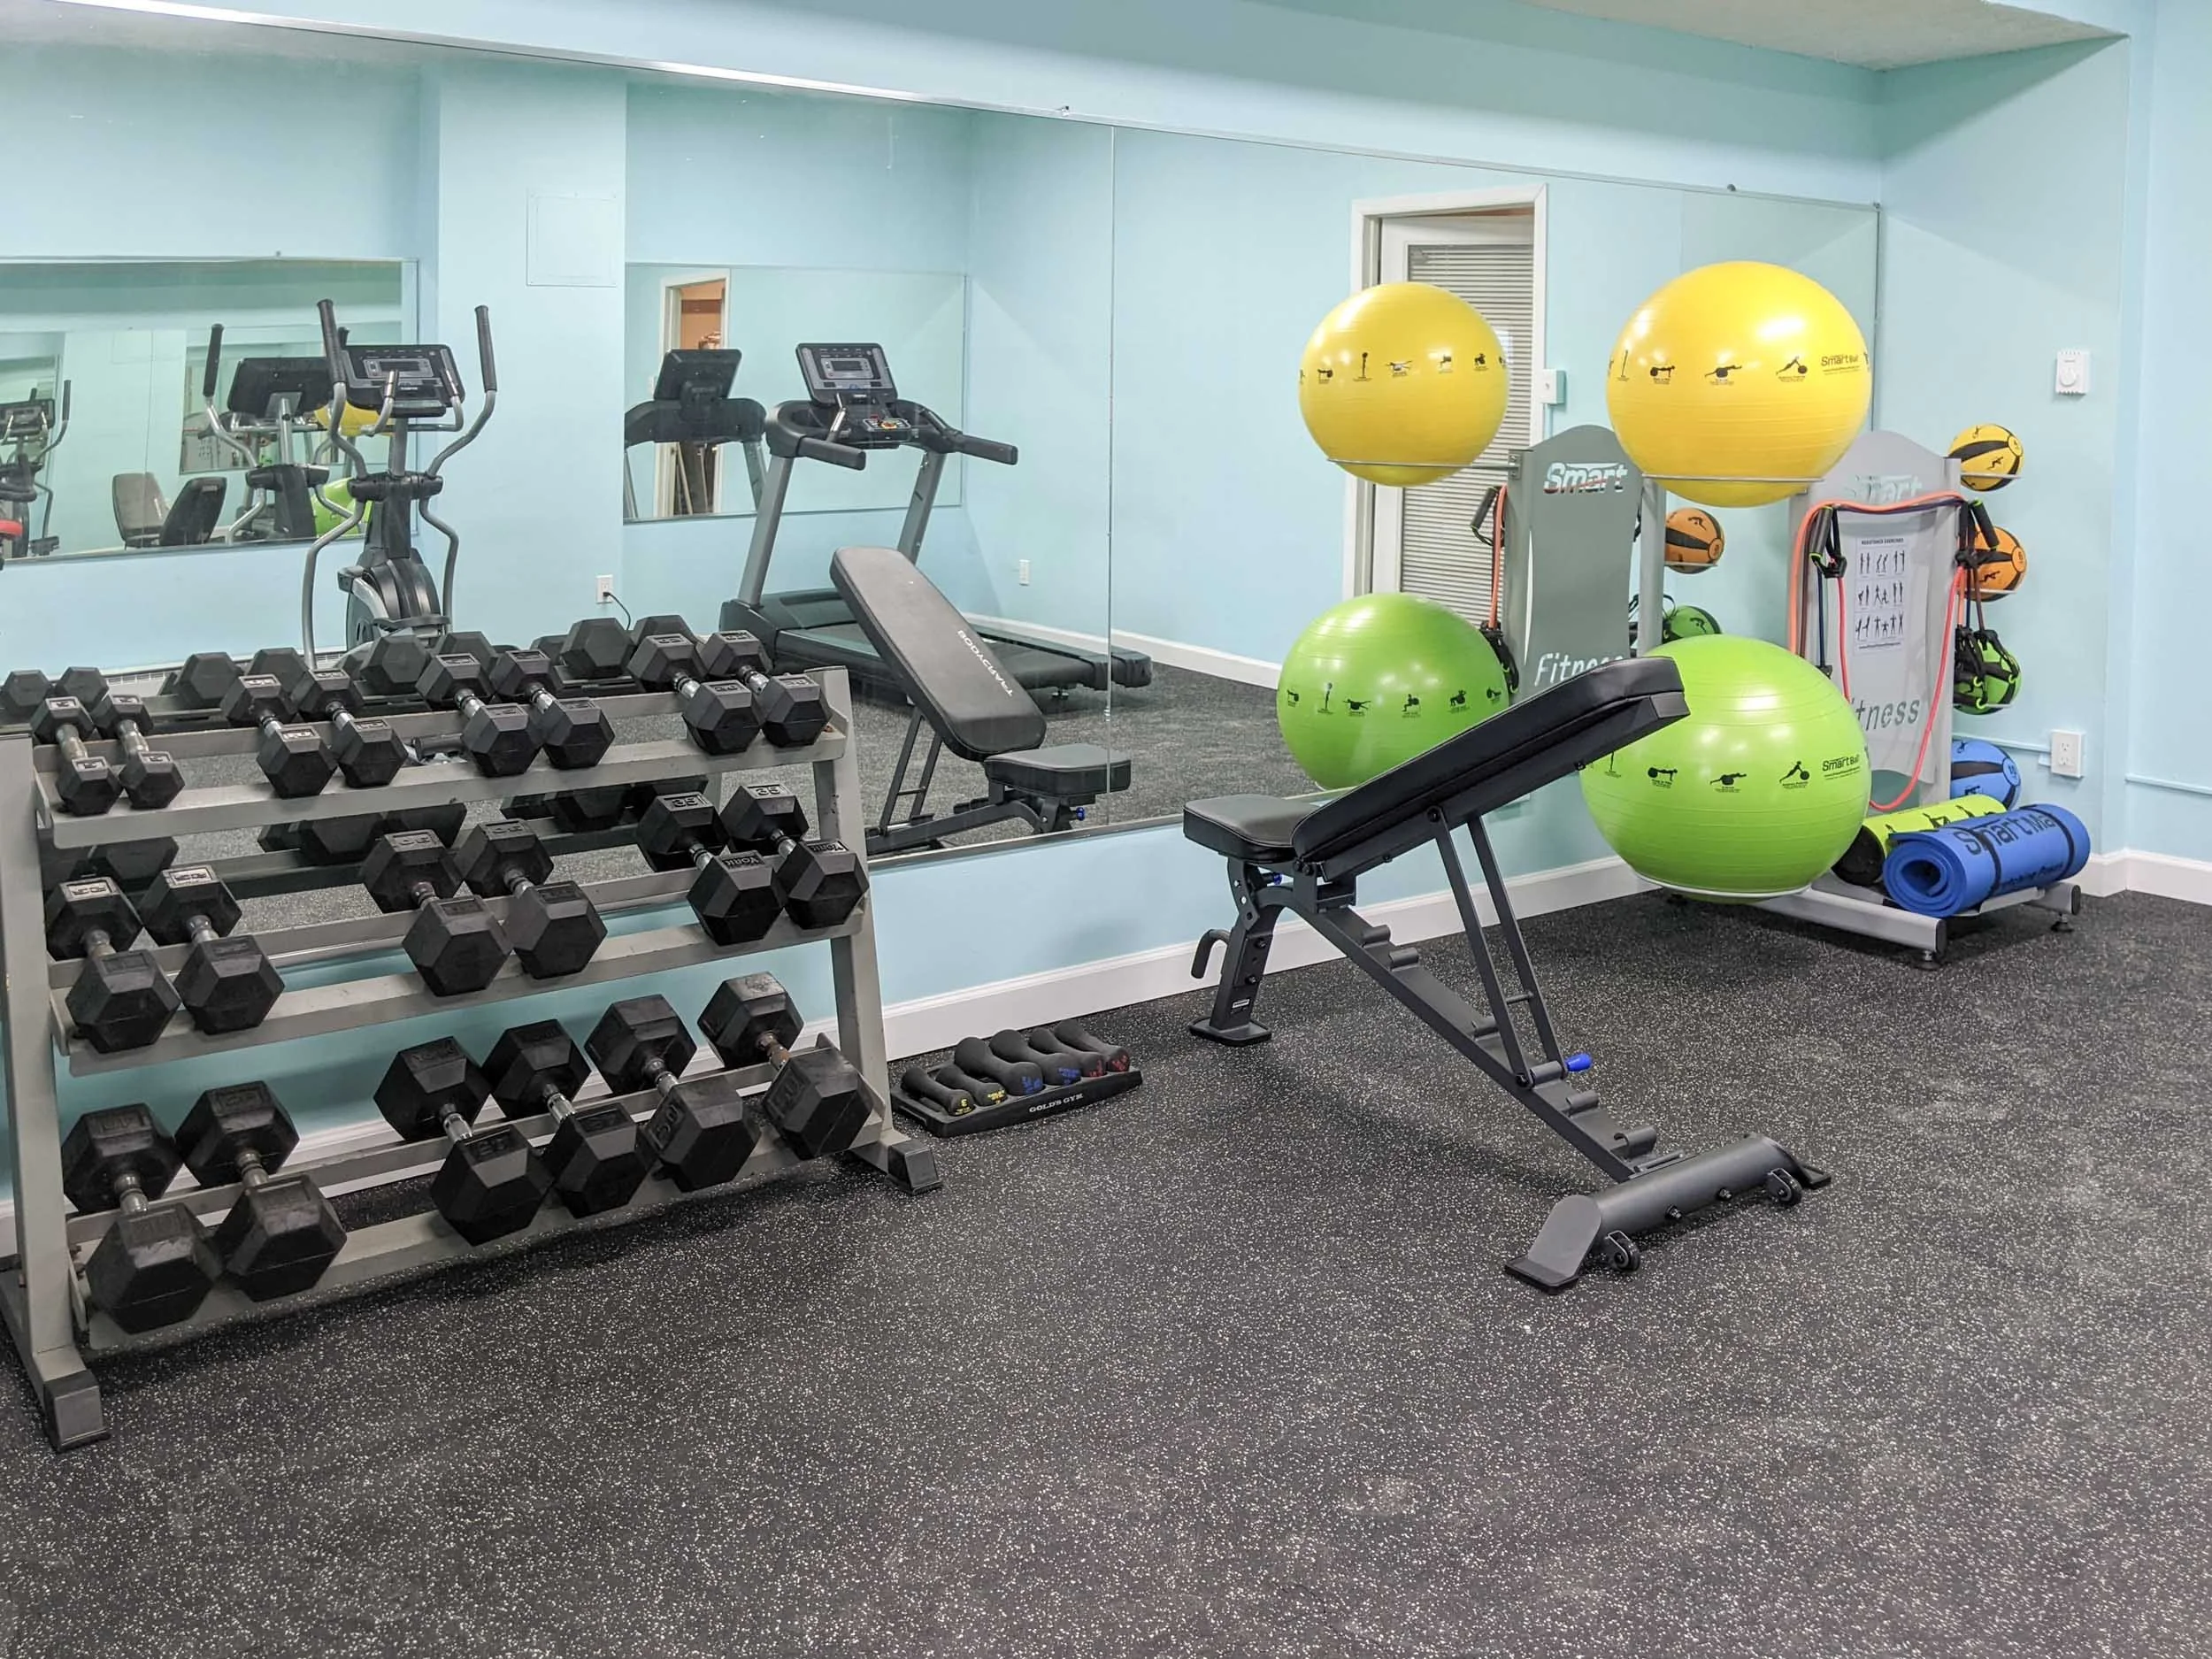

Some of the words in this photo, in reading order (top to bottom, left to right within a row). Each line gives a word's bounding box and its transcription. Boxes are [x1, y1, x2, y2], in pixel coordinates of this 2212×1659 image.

[1821, 354, 1849, 366] Smart
[1543, 462, 1628, 494] Smart
[1534, 652, 1624, 687] Fitne
[1851, 697, 1921, 731] tness
[1822, 757, 1850, 772] Smart
[756, 787, 780, 797] 35
[671, 797, 698, 810] 35
[1028, 1100, 1062, 1113] GOLD'S
[1063, 1093, 1084, 1103] GYM
